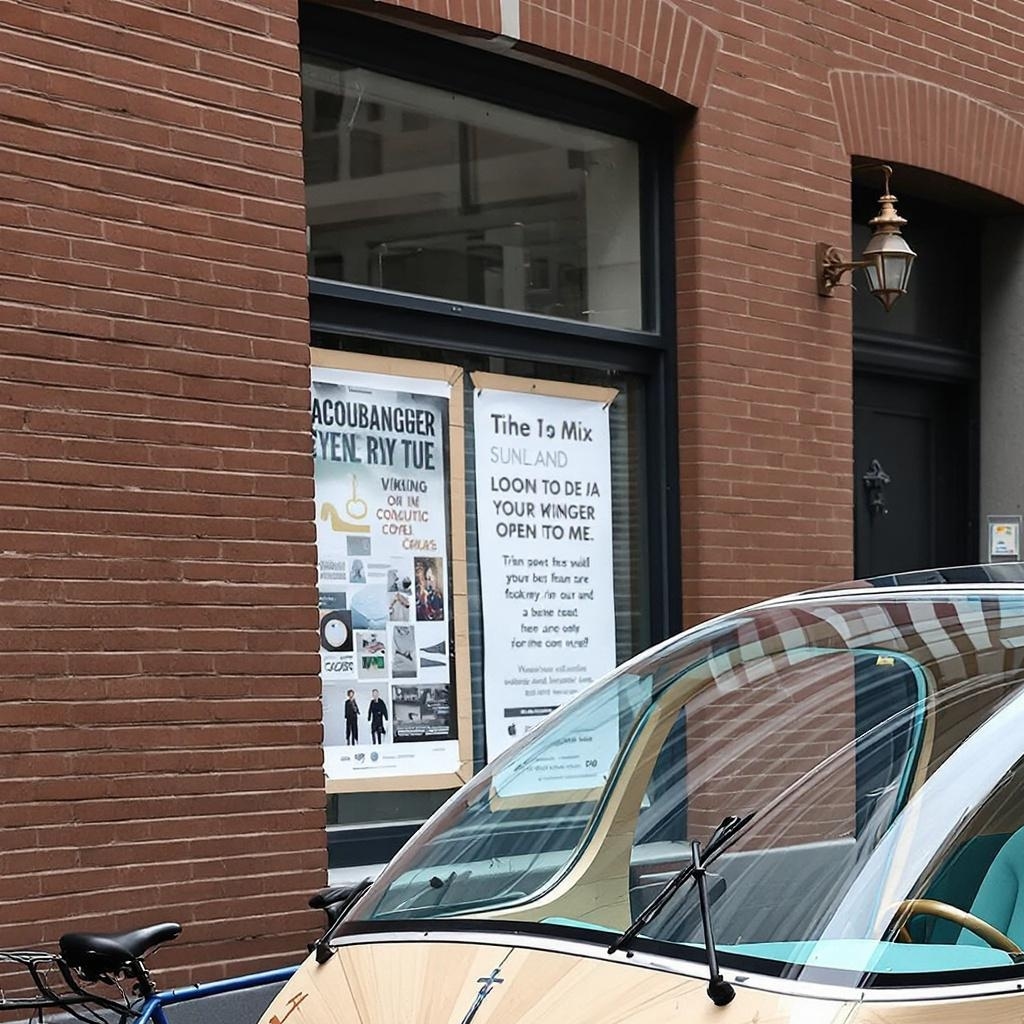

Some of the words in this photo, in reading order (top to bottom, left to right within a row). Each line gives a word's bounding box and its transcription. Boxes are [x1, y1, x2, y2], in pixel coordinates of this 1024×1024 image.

[561, 420, 593, 442] Mix
[401, 439, 435, 471] TUE
[490, 446, 568, 469] SUNLAND
[491, 476, 537, 494] LOON
[542, 479, 561, 495] TO
[565, 480, 582, 496] DE
[493, 500, 535, 518] YOUR
[496, 522, 537, 539] OPEN
[542, 524, 564, 540] TO
